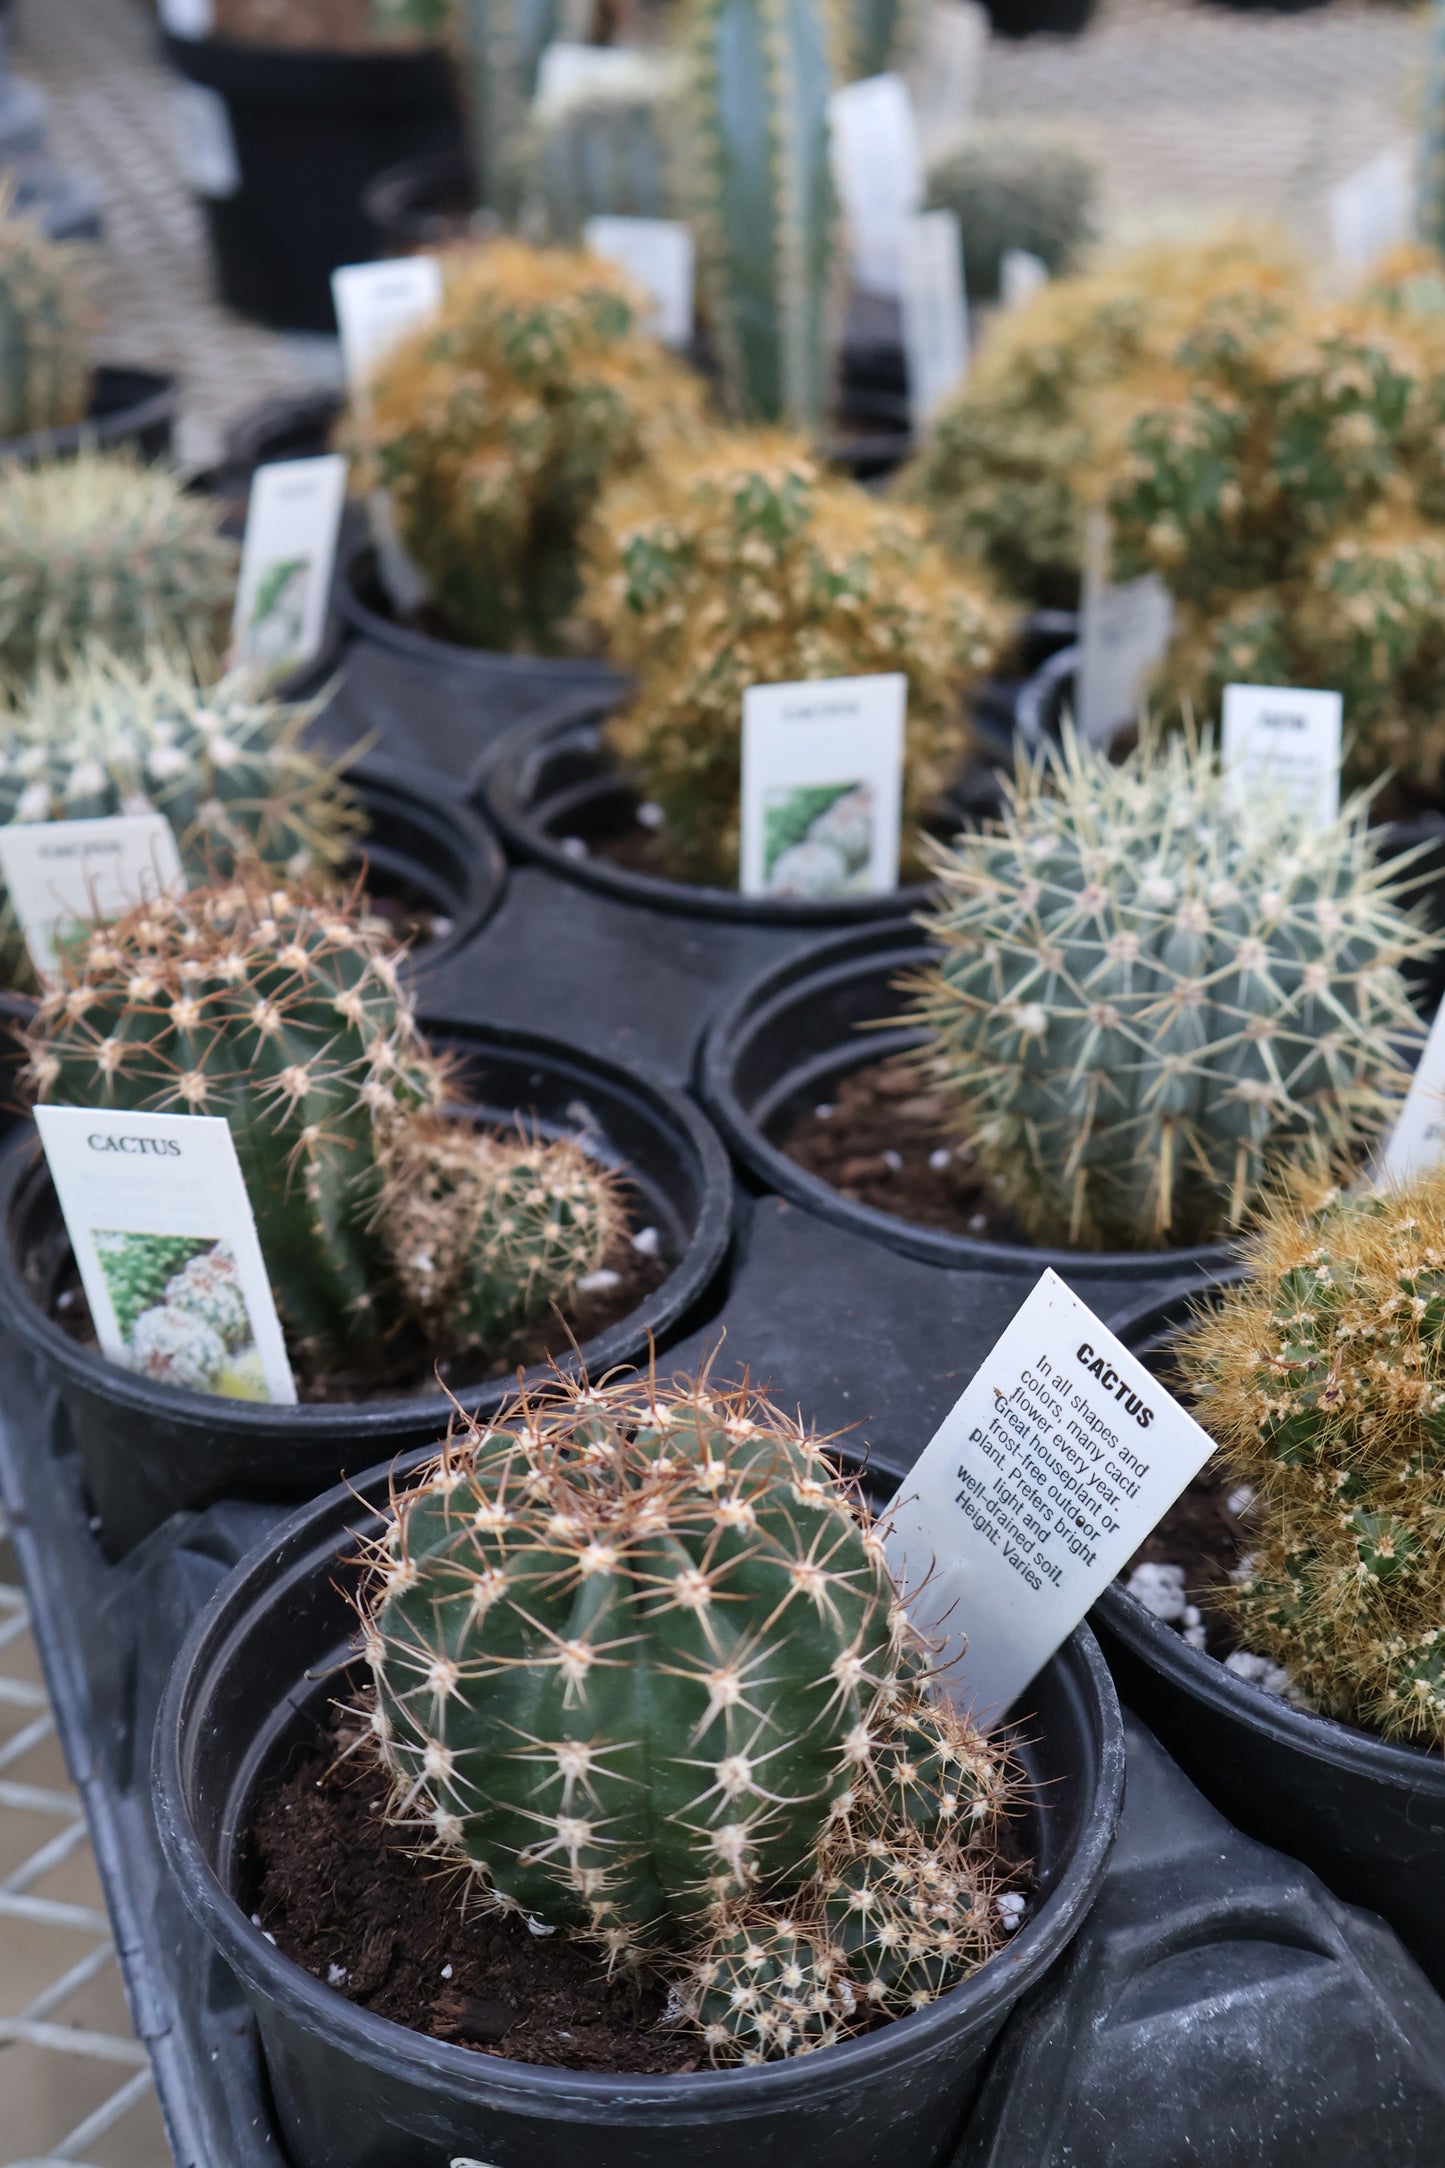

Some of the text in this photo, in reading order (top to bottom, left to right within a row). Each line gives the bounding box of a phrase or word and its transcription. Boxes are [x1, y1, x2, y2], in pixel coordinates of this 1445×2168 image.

[87, 1134, 182, 1156] CACTUS
[1021, 1370, 1141, 1499] colors, many cacti
[1036, 1355, 1150, 1479] In all shapes and
[1076, 1343, 1154, 1428] CACTUS
[968, 1428, 1097, 1567] plant. Prefers bright
[989, 1418, 1101, 1542] frost-free outdoor
[992, 1477, 1051, 1543] light and
[994, 1396, 1120, 1535] Great houseplant or
[1011, 1387, 1120, 1512] flower every year.
[955, 1490, 1043, 1591] Height: Varies
[957, 1465, 1063, 1588] well-drained soil.
